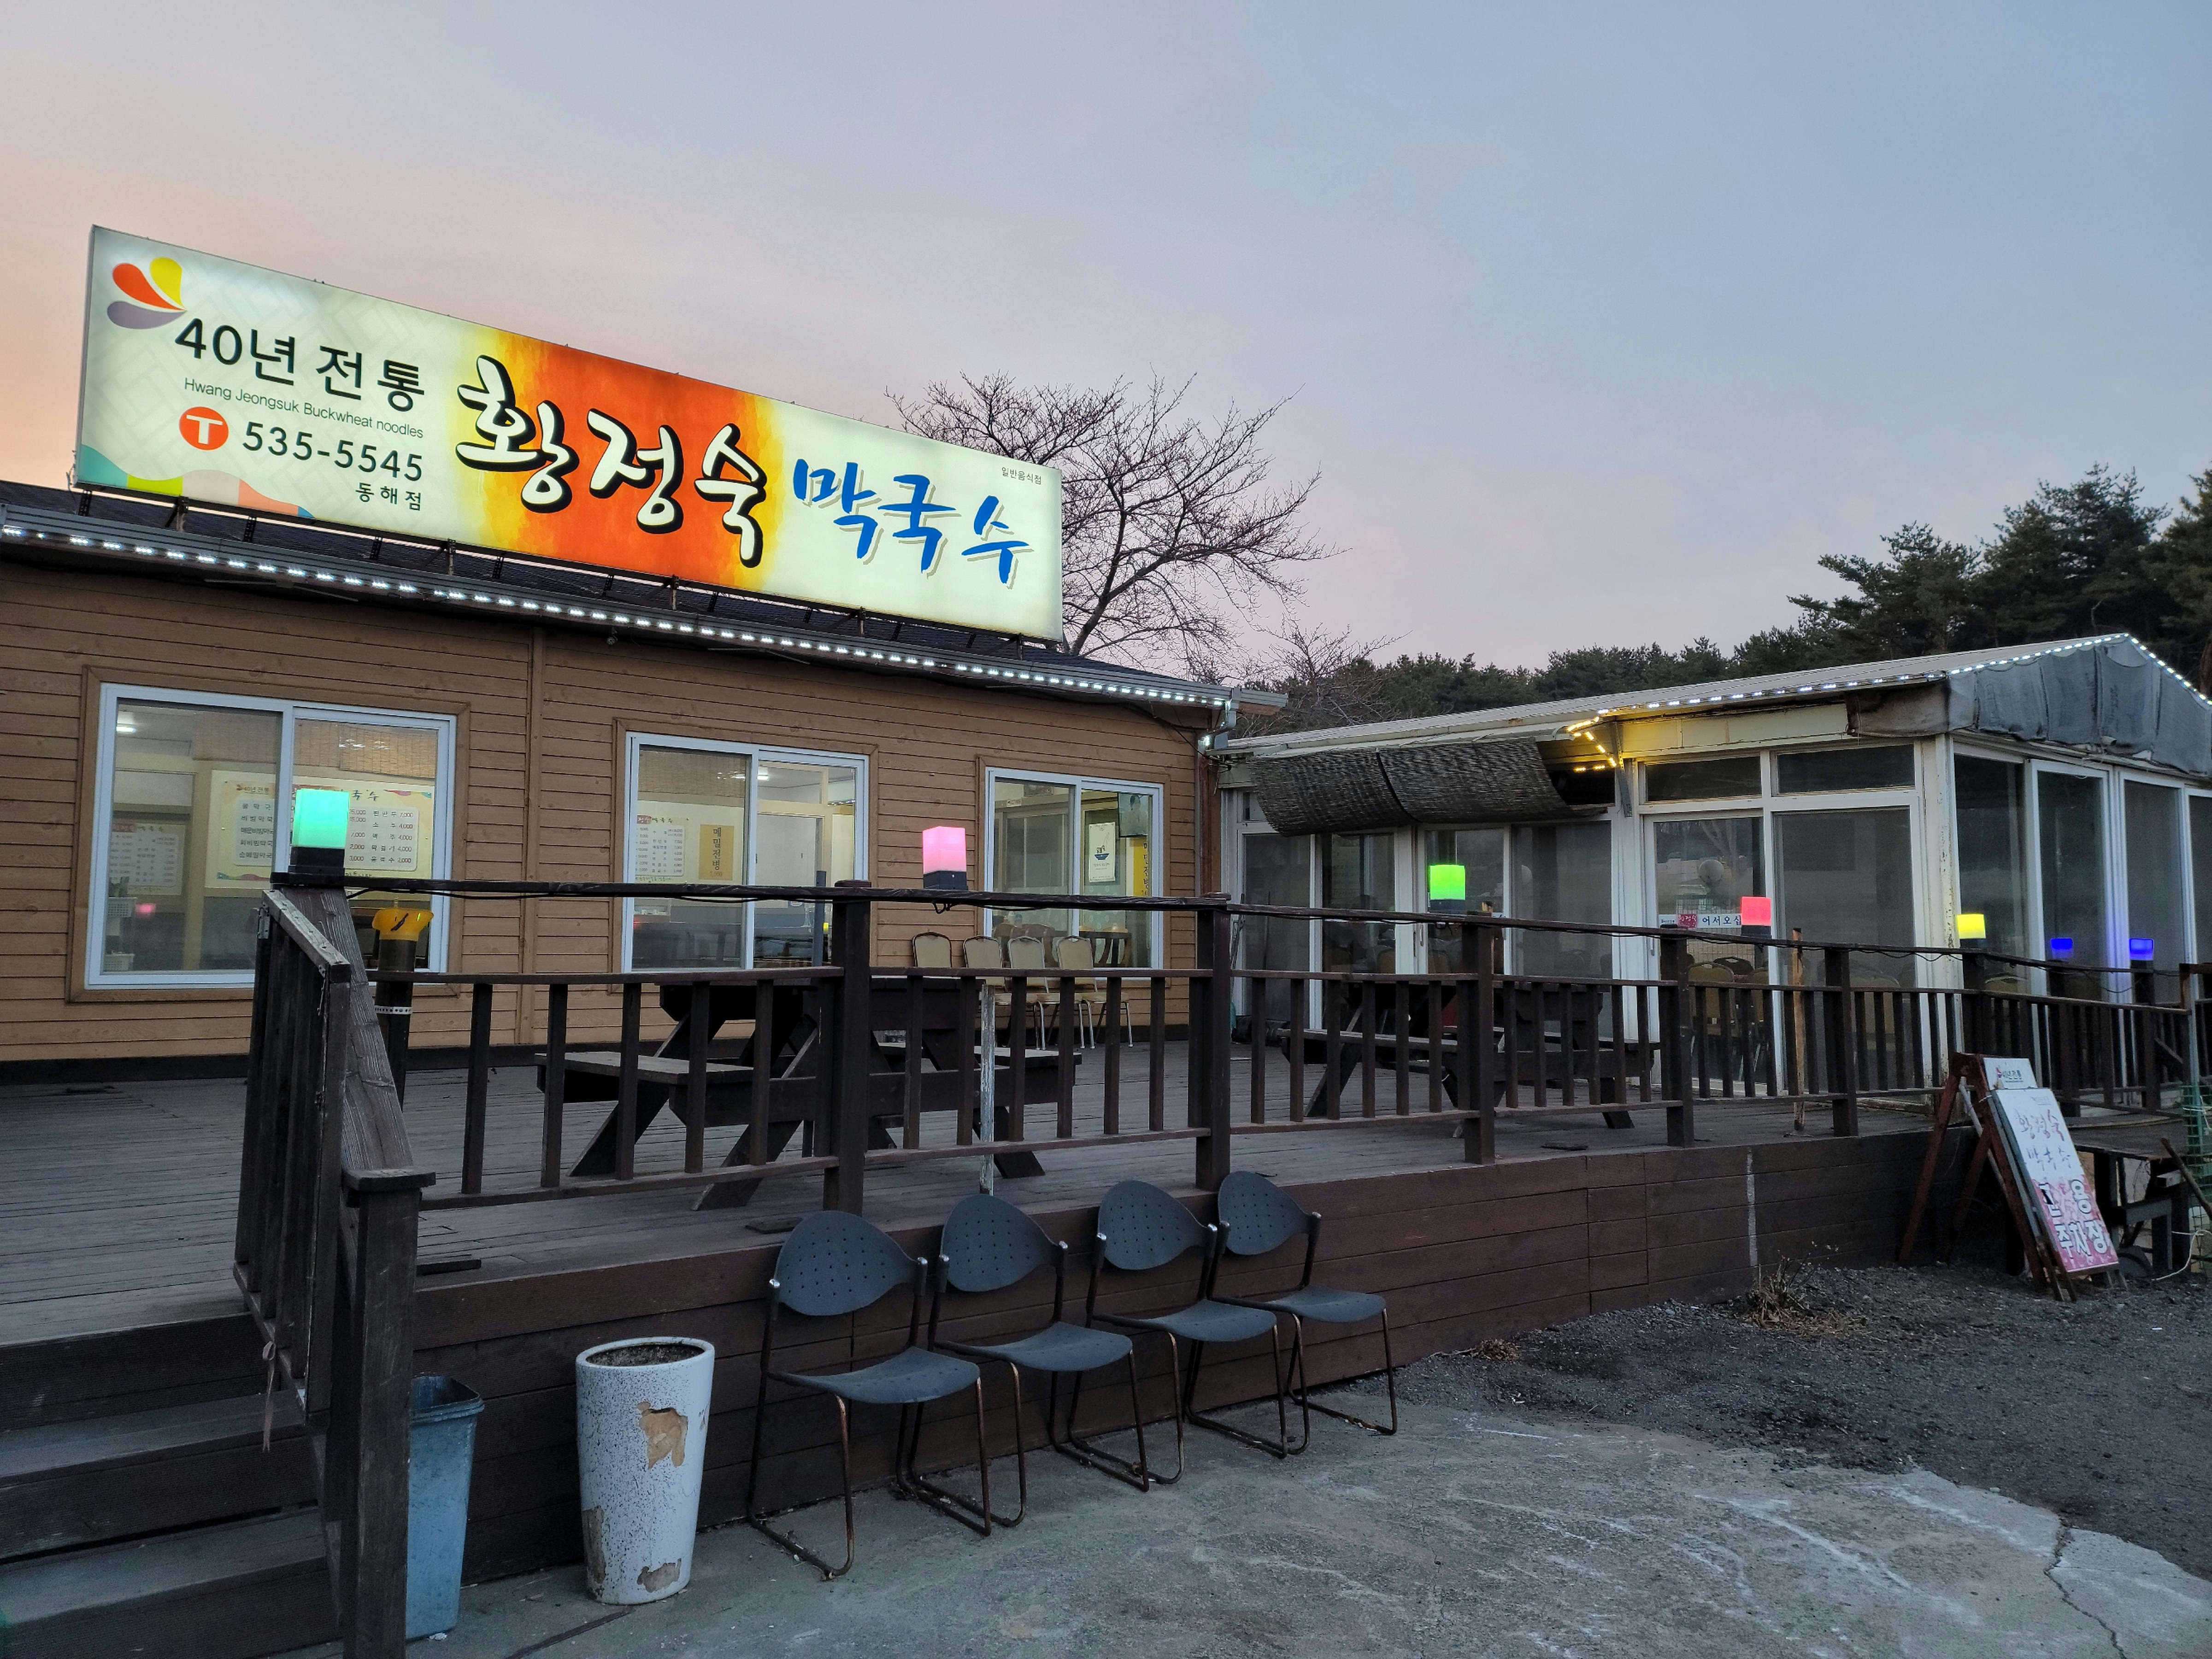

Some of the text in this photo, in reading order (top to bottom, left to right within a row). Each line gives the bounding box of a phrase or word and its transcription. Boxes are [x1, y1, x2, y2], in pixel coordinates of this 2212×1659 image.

[175, 318, 425, 412] 40년 전통
[184, 377, 424, 438] Hwang Jeongsuk Buckwheat noodles
[242, 421, 423, 481] 535-5545
[455, 354, 767, 568] 황정숙
[1001, 467, 1042, 485] 일반음식점
[355, 482, 422, 511] 동해점
[793, 459, 1031, 586] 막국수
[712, 827, 721, 871] 메밀전병
[2054, 1219, 2107, 1259] 주차장
